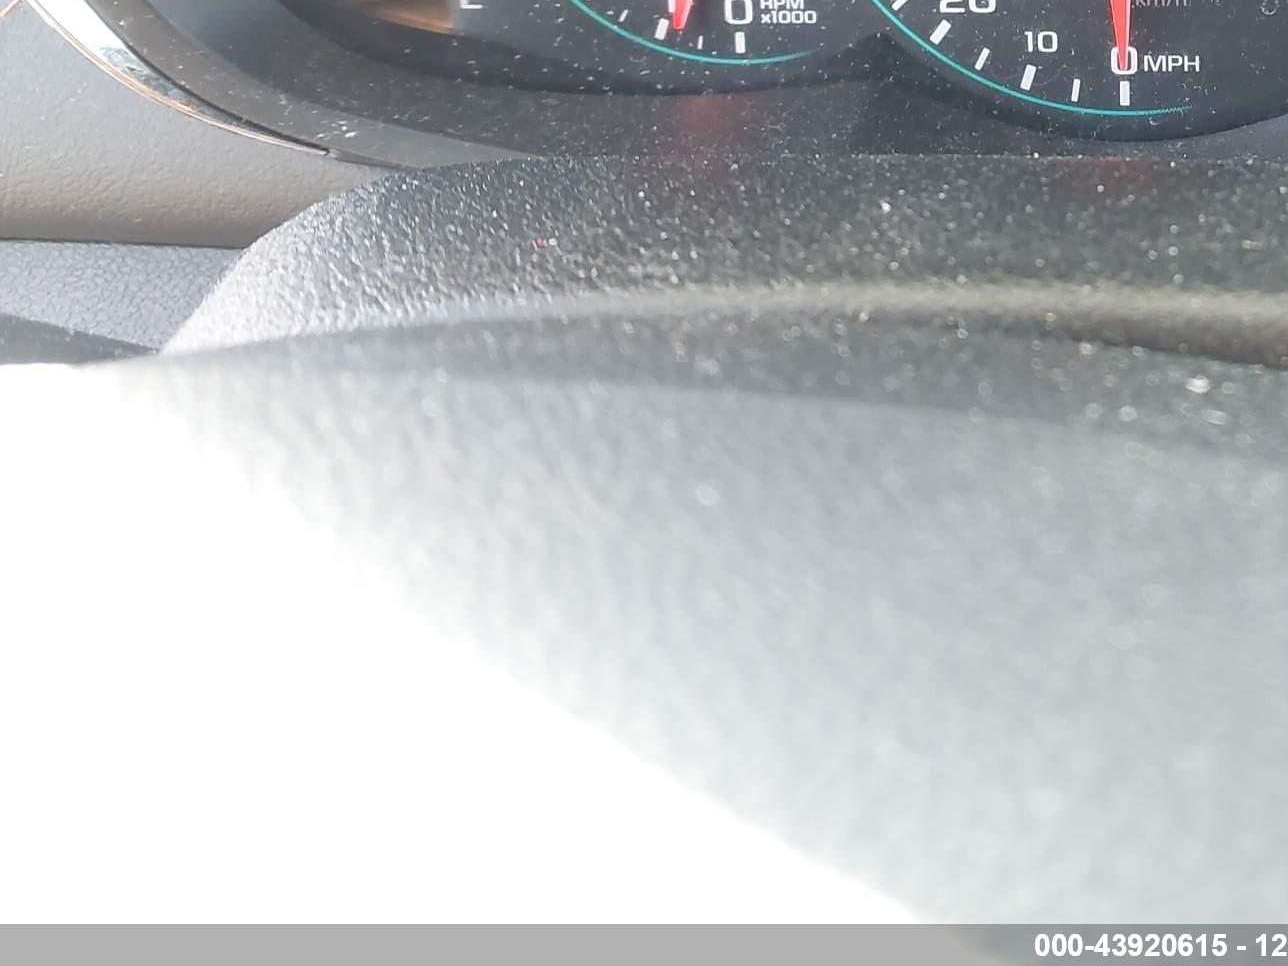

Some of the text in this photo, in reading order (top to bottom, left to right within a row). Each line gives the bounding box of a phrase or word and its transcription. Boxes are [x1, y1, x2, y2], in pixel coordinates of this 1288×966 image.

[760, 10, 817, 25] x1000
[1024, 31, 1058, 52] 10
[1143, 55, 1200, 72] MPH
